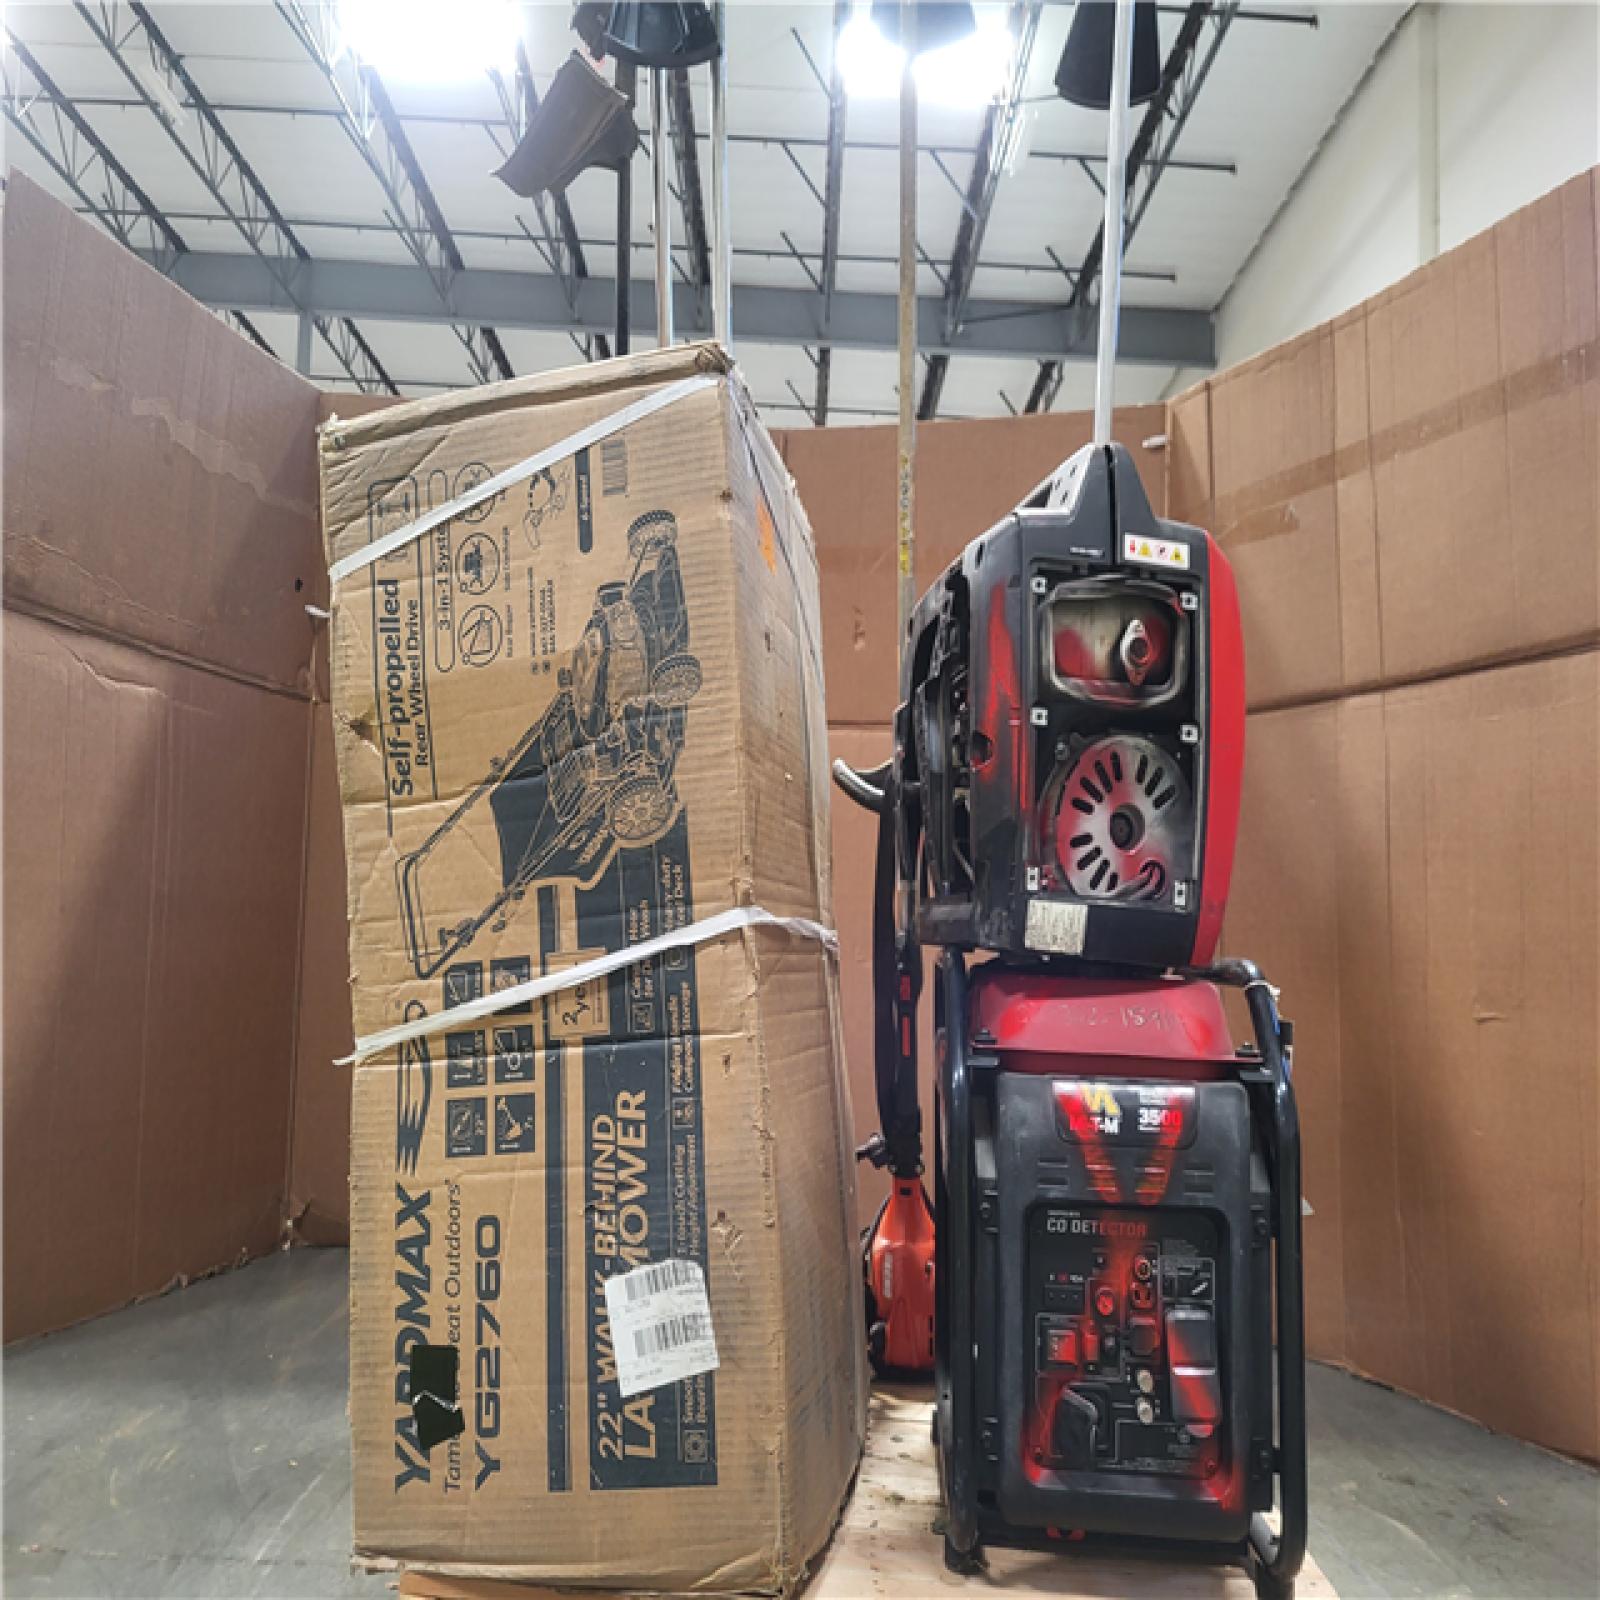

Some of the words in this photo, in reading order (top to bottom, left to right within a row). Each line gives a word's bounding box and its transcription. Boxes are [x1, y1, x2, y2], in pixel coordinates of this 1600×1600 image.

[435, 522, 451, 574] Syste
[405, 599, 419, 650] Drive
[436, 577, 451, 631] 3-in-1
[377, 579, 413, 796] Self-propelled
[405, 655, 424, 717] Wheel
[415, 722, 428, 767] Rear
[1046, 1219, 1067, 1234] CO
[1071, 1219, 1149, 1237] DETECTOR
[474, 1214, 501, 1491] YG2760
[596, 1391, 624, 1460] 22"
